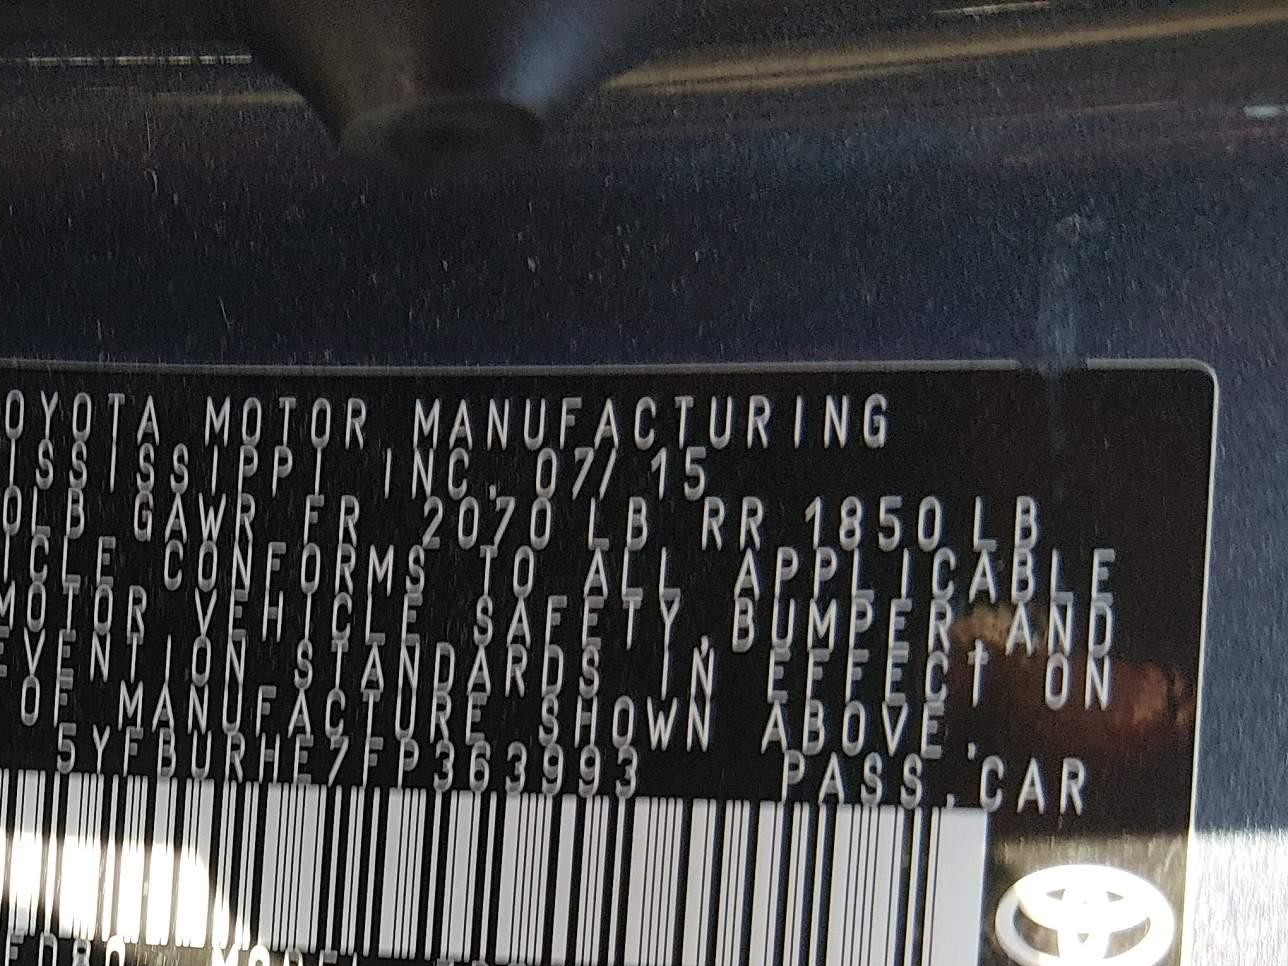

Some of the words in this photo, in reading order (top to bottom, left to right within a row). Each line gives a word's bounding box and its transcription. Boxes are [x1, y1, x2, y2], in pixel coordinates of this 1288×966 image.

[205, 395, 367, 449] MOTOR
[413, 394, 889, 451] MANUFACTURING
[383, 447, 498, 501] INC.
[536, 446, 708, 501] 07/15
[133, 491, 256, 544] GAWR
[302, 494, 361, 545] FR
[701, 496, 764, 551] RR
[163, 540, 426, 596] CONFORMS
[479, 546, 536, 599] TO
[583, 547, 682, 601] ALL
[733, 548, 1116, 606] APPLICABLE
[194, 588, 420, 645] VEHICLE
[1005, 598, 1115, 658] AND
[294, 638, 600, 699] STANDARDS
[660, 649, 715, 702] IN
[766, 640, 989, 708] EFFECT
[1044, 653, 1114, 712] ON
[20, 675, 75, 727] OF
[118, 681, 487, 746] MANUFACTURE
[538, 692, 712, 753] SHOWN
[760, 701, 978, 761] ABOVE.
[56, 722, 640, 800] 5YFBURHE7FP363993
